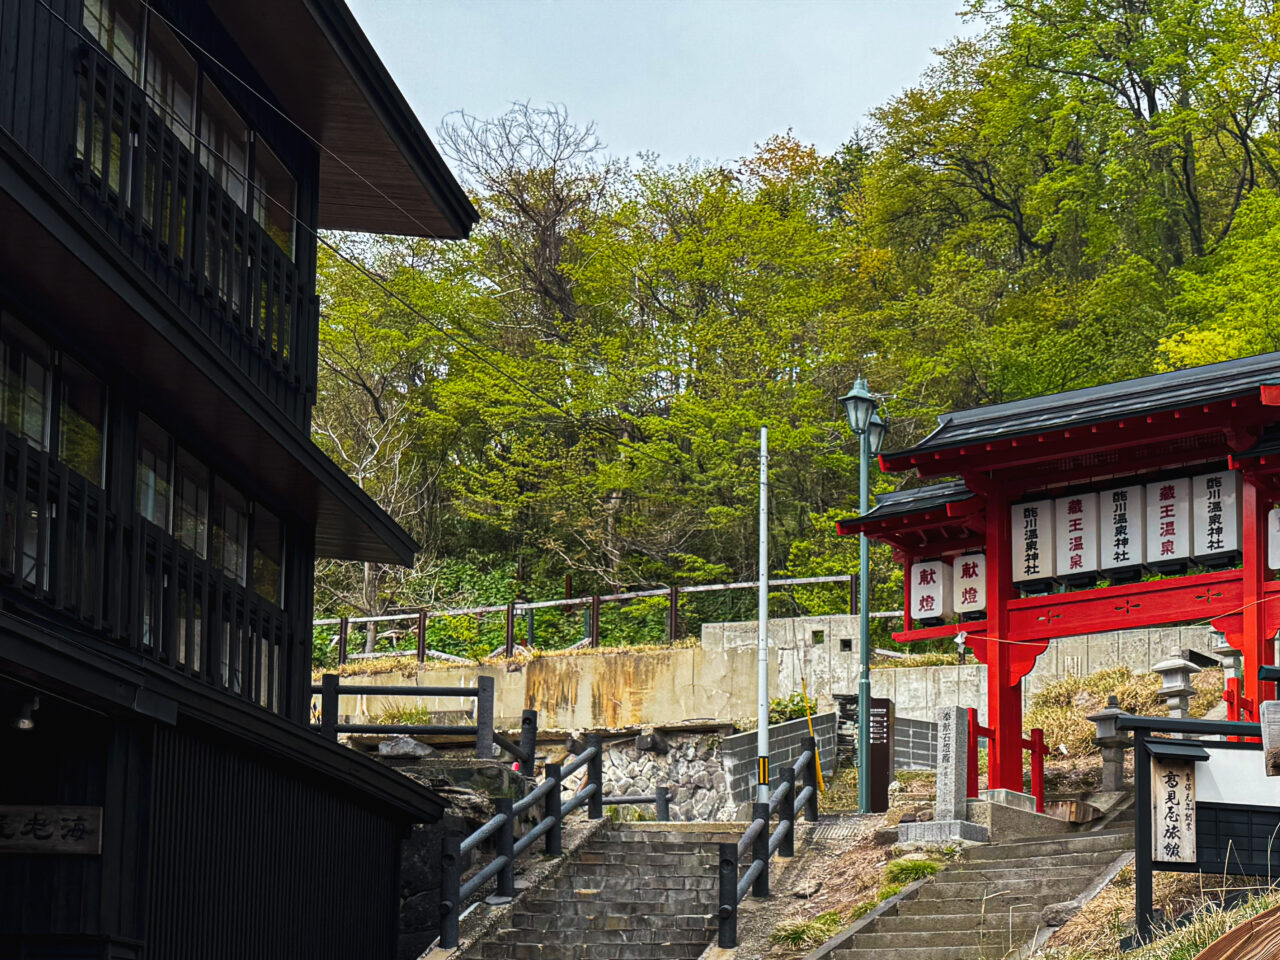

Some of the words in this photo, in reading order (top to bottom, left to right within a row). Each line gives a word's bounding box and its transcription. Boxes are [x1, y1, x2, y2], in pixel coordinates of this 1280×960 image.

[1067, 498, 1084, 570] 蔵王温泉
[1159, 484, 1177, 557] 蔵王温泉
[918, 568, 937, 612] 献燈
[960, 561, 979, 605] 献燈
